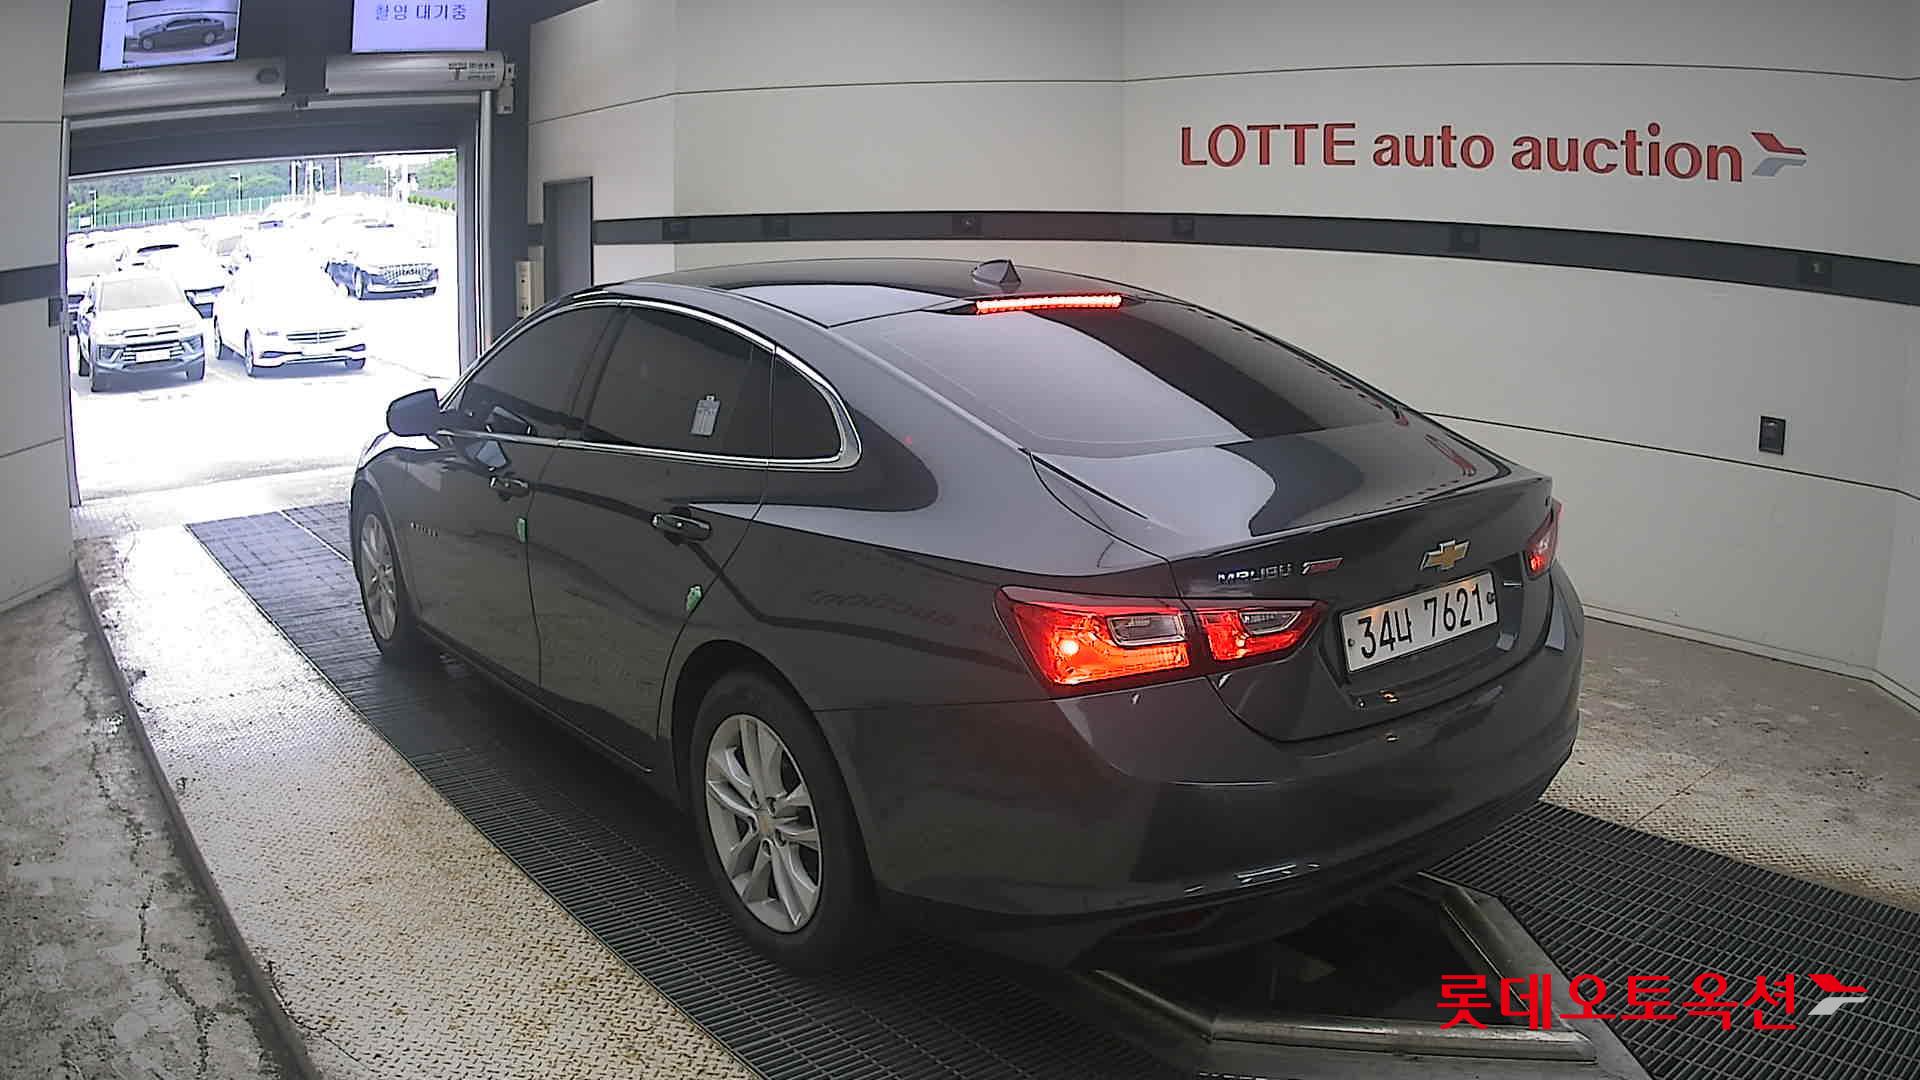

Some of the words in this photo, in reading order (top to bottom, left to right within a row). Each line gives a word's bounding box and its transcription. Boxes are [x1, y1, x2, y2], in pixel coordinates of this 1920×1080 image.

[416, 4, 467, 21] 대기중
[1180, 122, 1356, 167] LOTTE
[1372, 125, 1496, 169] auto
[1511, 122, 1744, 182] auction
[1217, 562, 1292, 585] MALIBU
[1357, 606, 1413, 659] 34나
[1424, 583, 1484, 638] 7621
